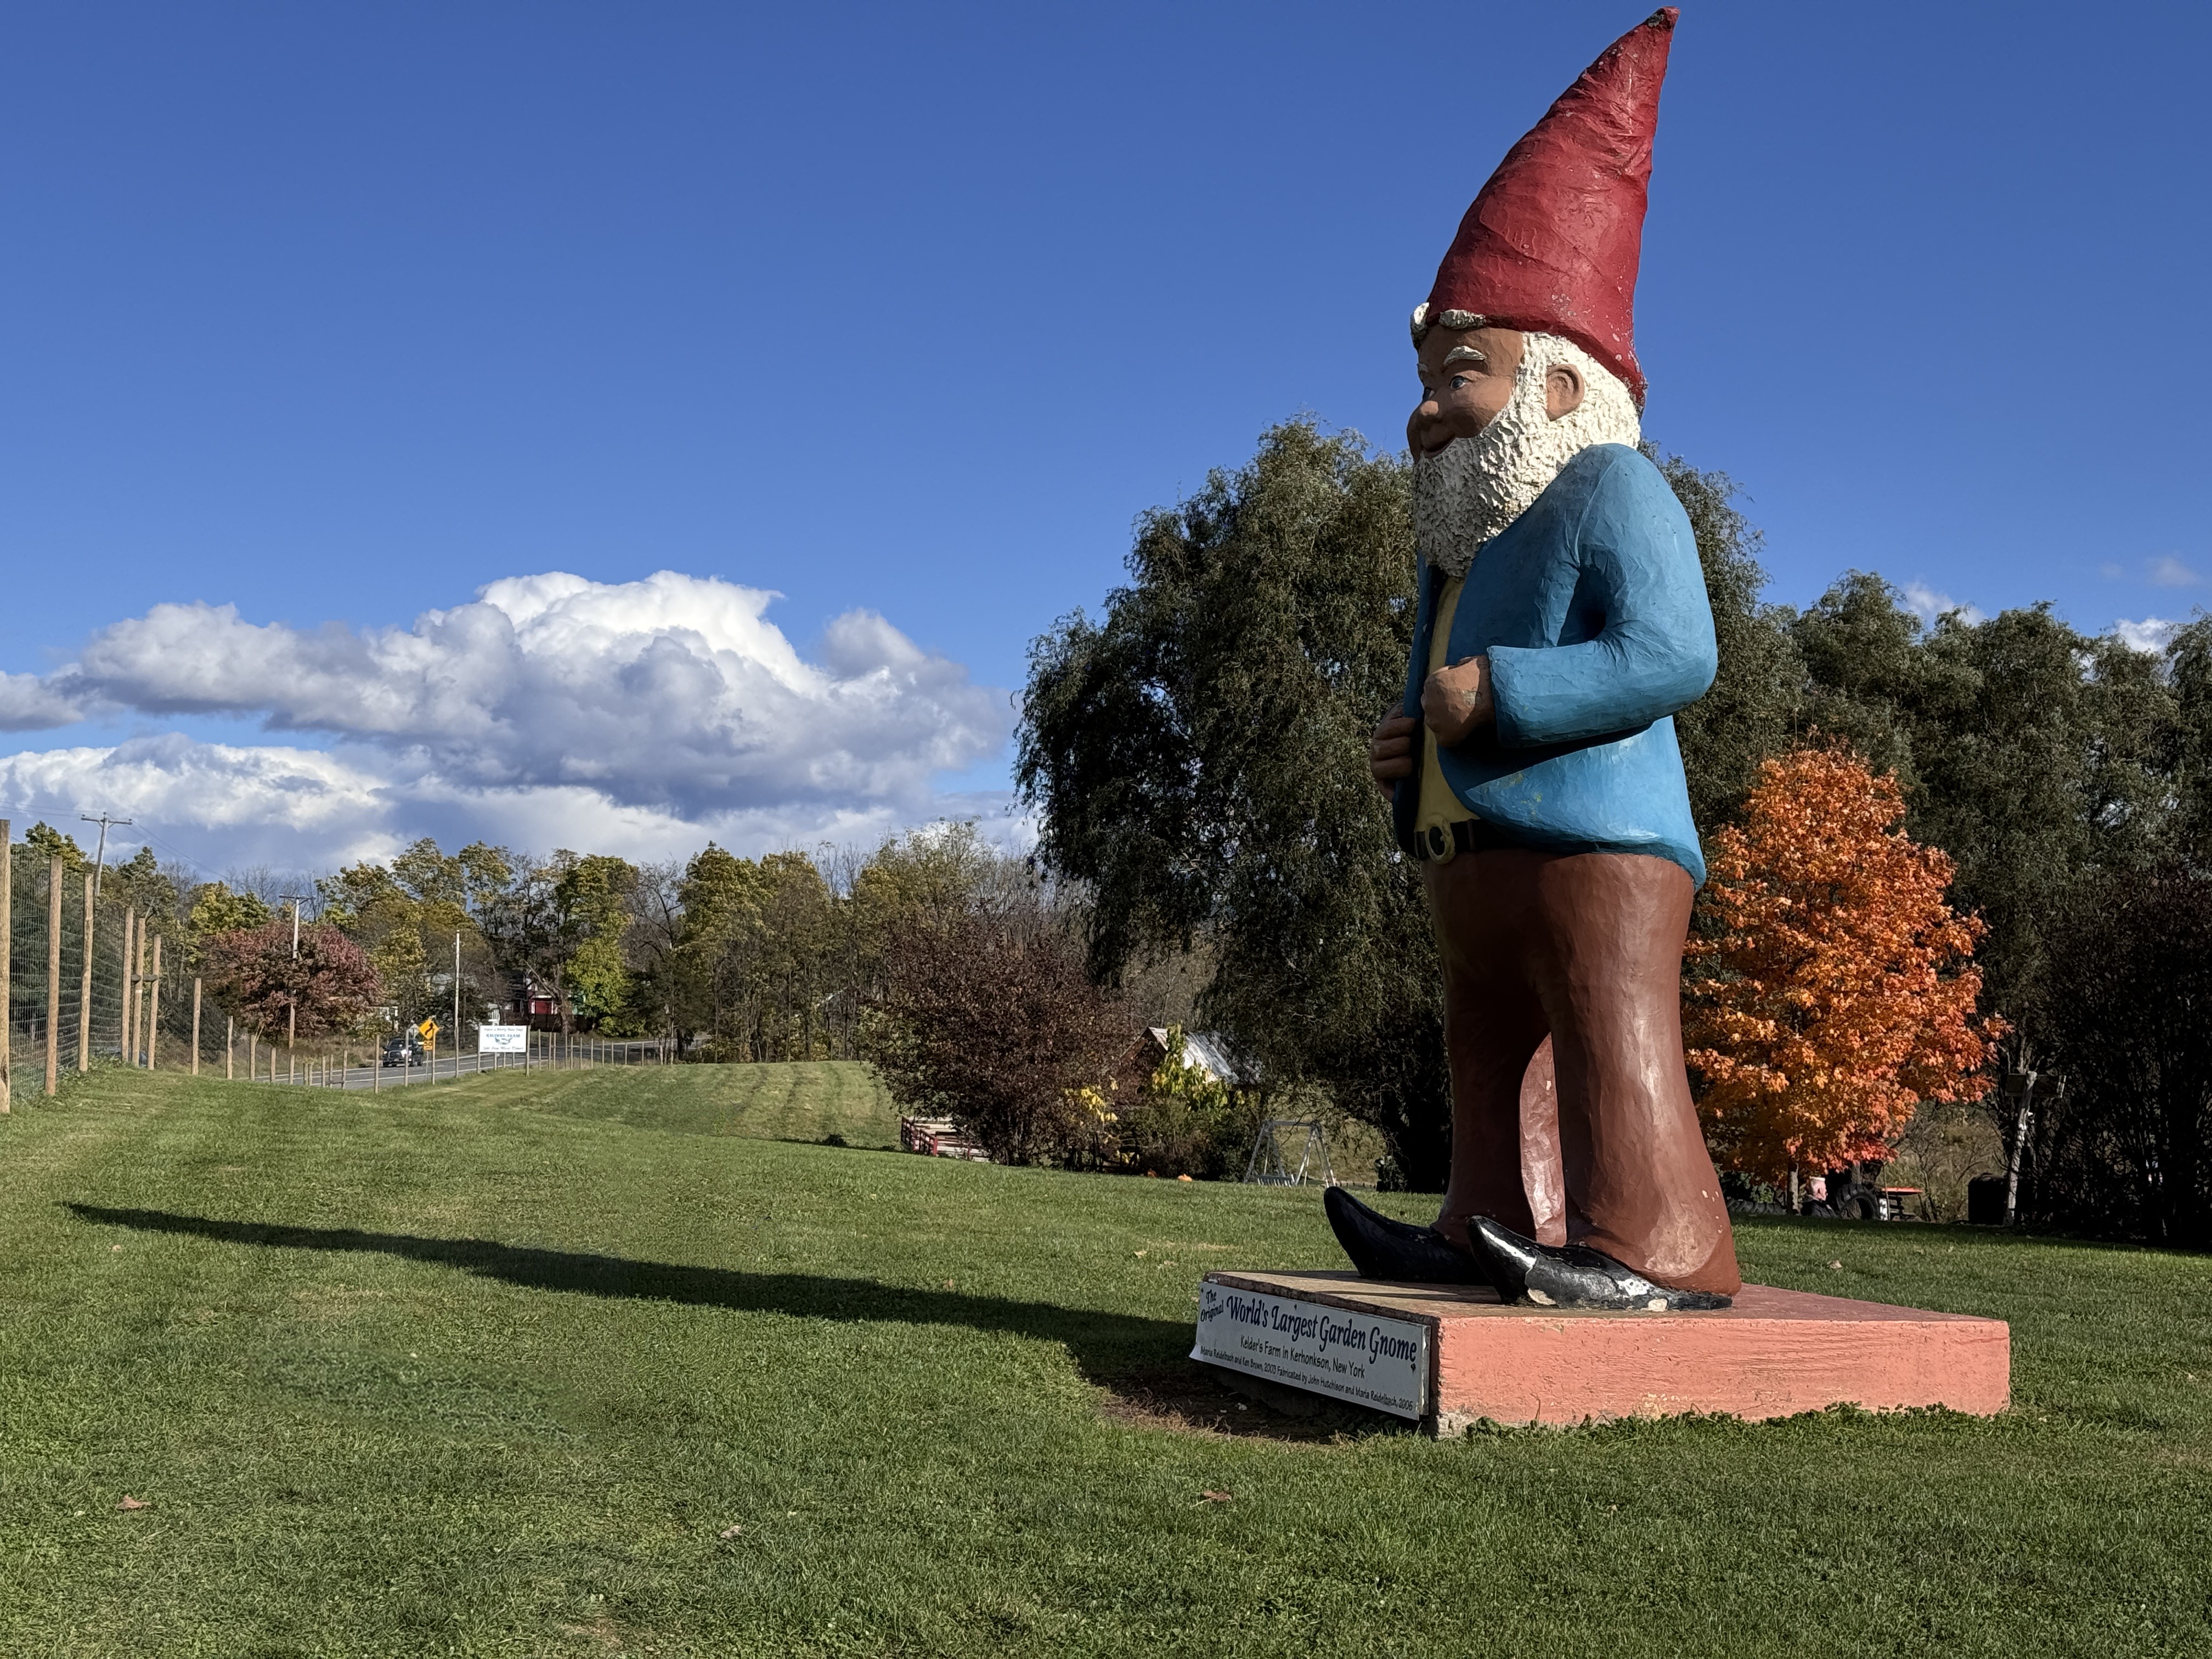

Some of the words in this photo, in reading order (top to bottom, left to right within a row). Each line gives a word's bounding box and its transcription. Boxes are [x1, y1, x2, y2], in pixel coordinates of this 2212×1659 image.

[1200, 1299, 1224, 1322] Original
[1206, 1289, 1217, 1304] The
[1227, 1295, 1269, 1328] World's
[1272, 1305, 1318, 1342] Largest
[1319, 1316, 1366, 1352] Garden
[1369, 1326, 1417, 1364] Gnome
[1200, 1345, 1213, 1357] Maria
[1264, 1362, 1276, 1374] 2003
[1277, 1365, 1301, 1381] Fabricated
[1301, 1372, 1307, 1385] by
[1308, 1374, 1319, 1386] John
[1345, 1385, 1355, 1395] and
[1355, 1386, 1369, 1400] Maria
[1240, 1334, 1263, 1353] Kelder's
[1265, 1341, 1281, 1358] Farm
[1290, 1346, 1331, 1372] Kerhonkson,
[1333, 1357, 1347, 1374] New
[1348, 1360, 1365, 1379] York
